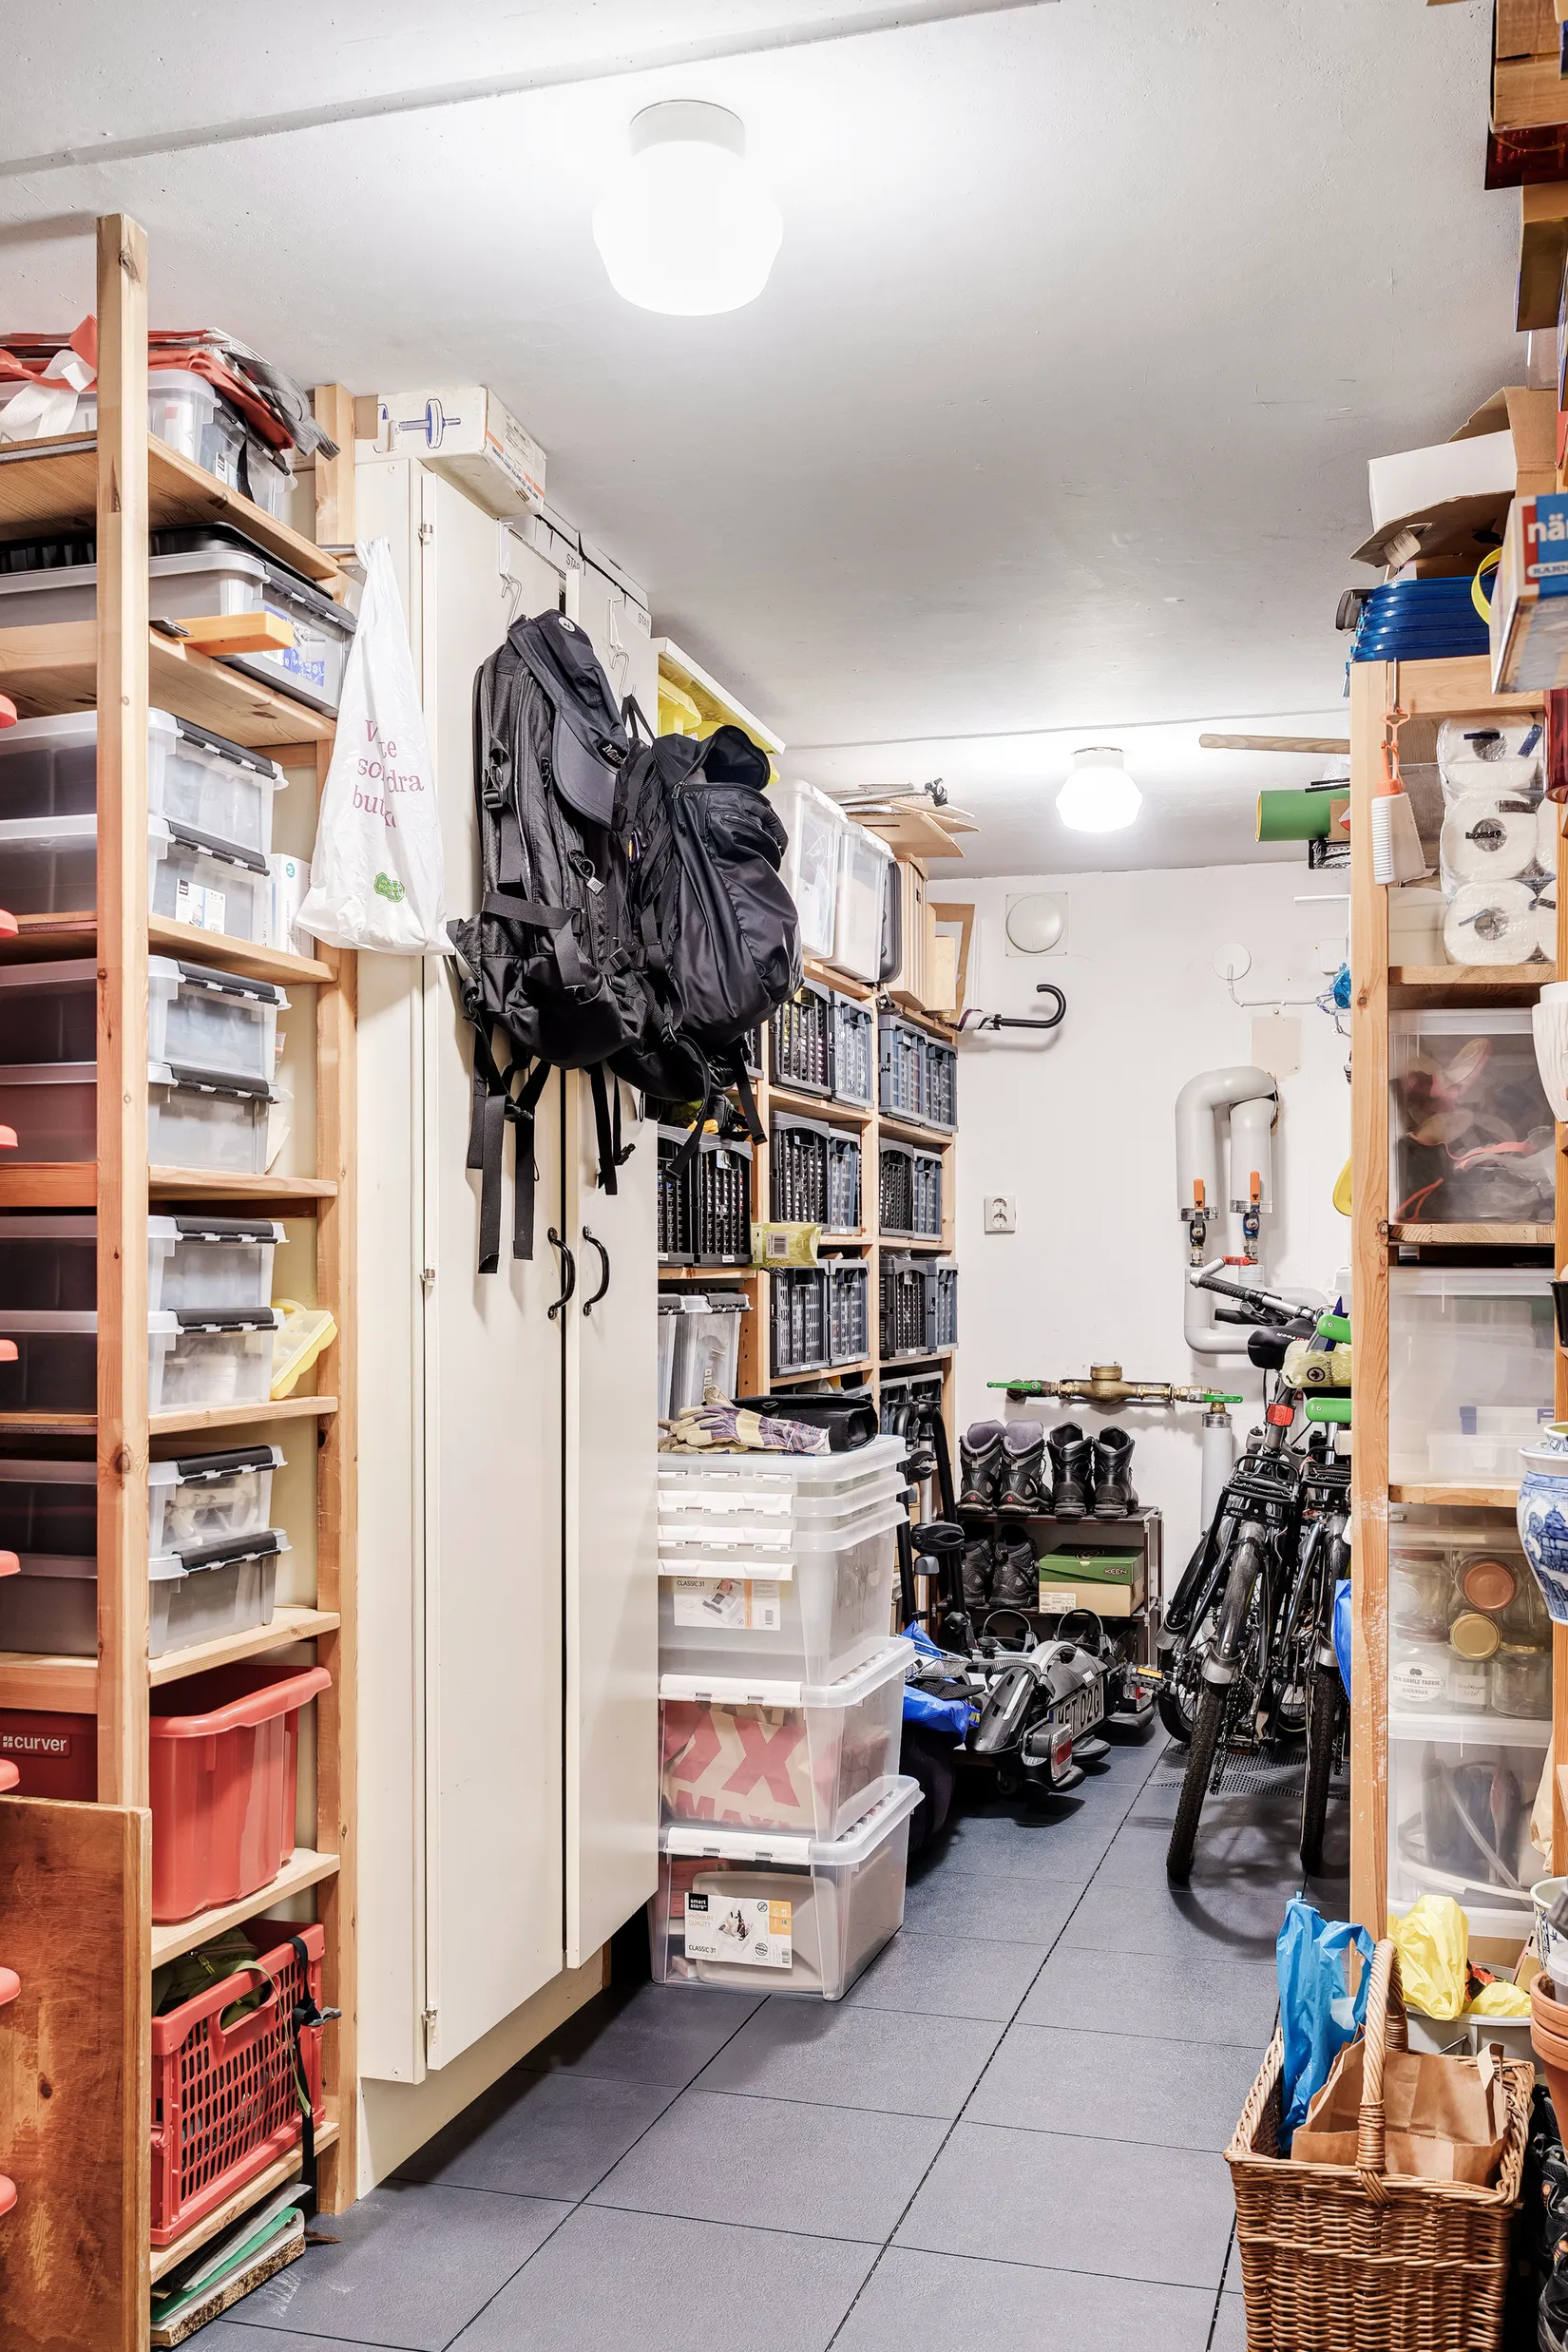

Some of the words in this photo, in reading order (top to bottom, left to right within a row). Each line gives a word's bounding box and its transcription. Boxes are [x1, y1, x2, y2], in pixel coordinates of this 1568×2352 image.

[1527, 513, 1568, 544] nä
[14, 1736, 67, 1751] curver
[689, 1913, 714, 1922] PREMIUM
[689, 1944, 709, 1953] CLASSIC
